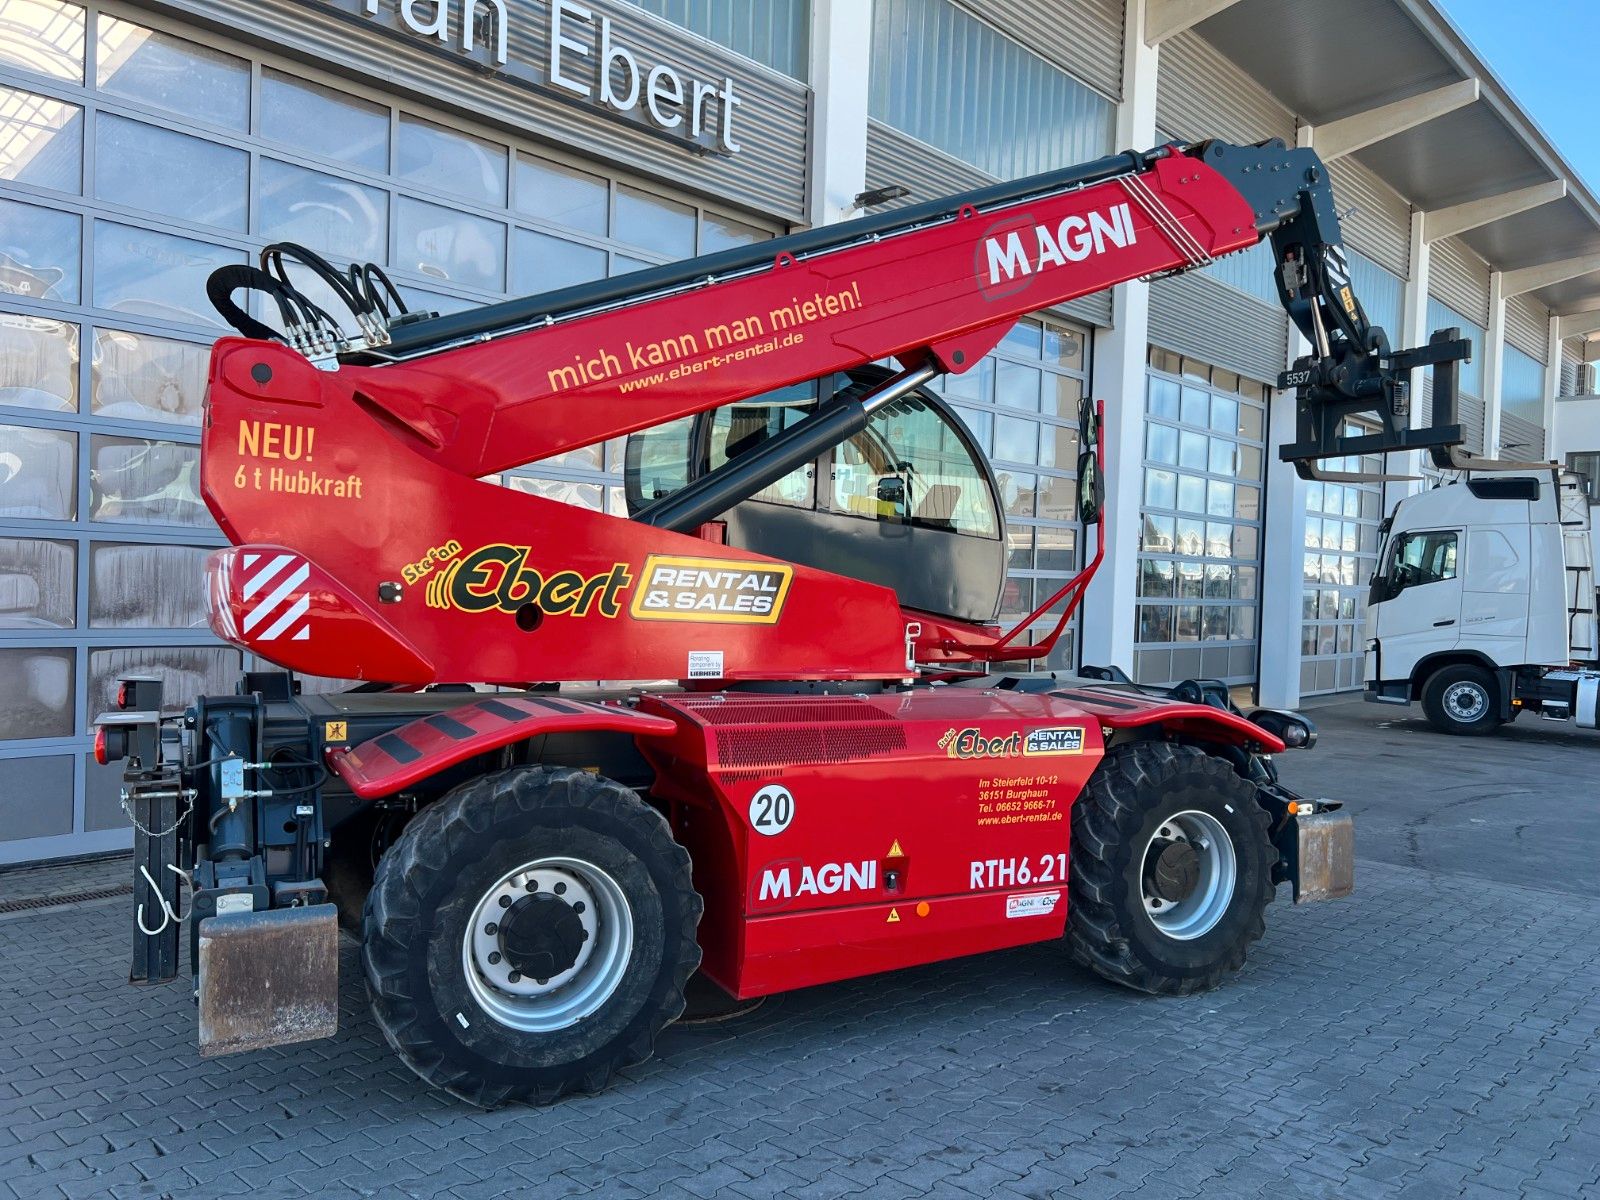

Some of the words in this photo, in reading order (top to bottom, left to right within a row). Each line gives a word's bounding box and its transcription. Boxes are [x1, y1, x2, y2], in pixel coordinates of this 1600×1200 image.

[366, 0, 508, 65] an
[550, 0, 741, 152] Ebert
[985, 202, 1137, 285] MAGNI
[547, 349, 622, 392] mich
[625, 333, 699, 370] kann
[704, 315, 763, 350] man
[769, 281, 863, 332] mieten!
[618, 332, 804, 394] www.ebert-rental.de
[1286, 371, 1310, 386] 5537
[238, 419, 315, 462] NEU!
[234, 464, 247, 489] 6
[254, 467, 262, 490] t
[269, 467, 363, 499] Hubkraft
[400, 539, 463, 586] Stefan
[651, 567, 777, 592] RENTAL
[451, 543, 634, 618] Ebert
[644, 590, 670, 608] &
[674, 591, 773, 613] SALES
[956, 728, 1022, 759] Ebert
[1028, 742, 1039, 751] &
[1040, 741, 1080, 750] SALES
[1029, 731, 1081, 741] RENTAL
[979, 778, 990, 788] Im
[1036, 775, 1058, 785] 10-12
[979, 791, 1004, 801] 36151
[1006, 789, 1049, 802] Burghaun
[755, 793, 790, 827] 20
[978, 811, 1063, 826] www.ebert-rental.de
[979, 804, 994, 814] Tel.
[996, 802, 1022, 812] 06652
[1024, 800, 1056, 810] 9666-71
[759, 860, 877, 901] MAGNI
[970, 853, 1066, 889] RTH6.21
